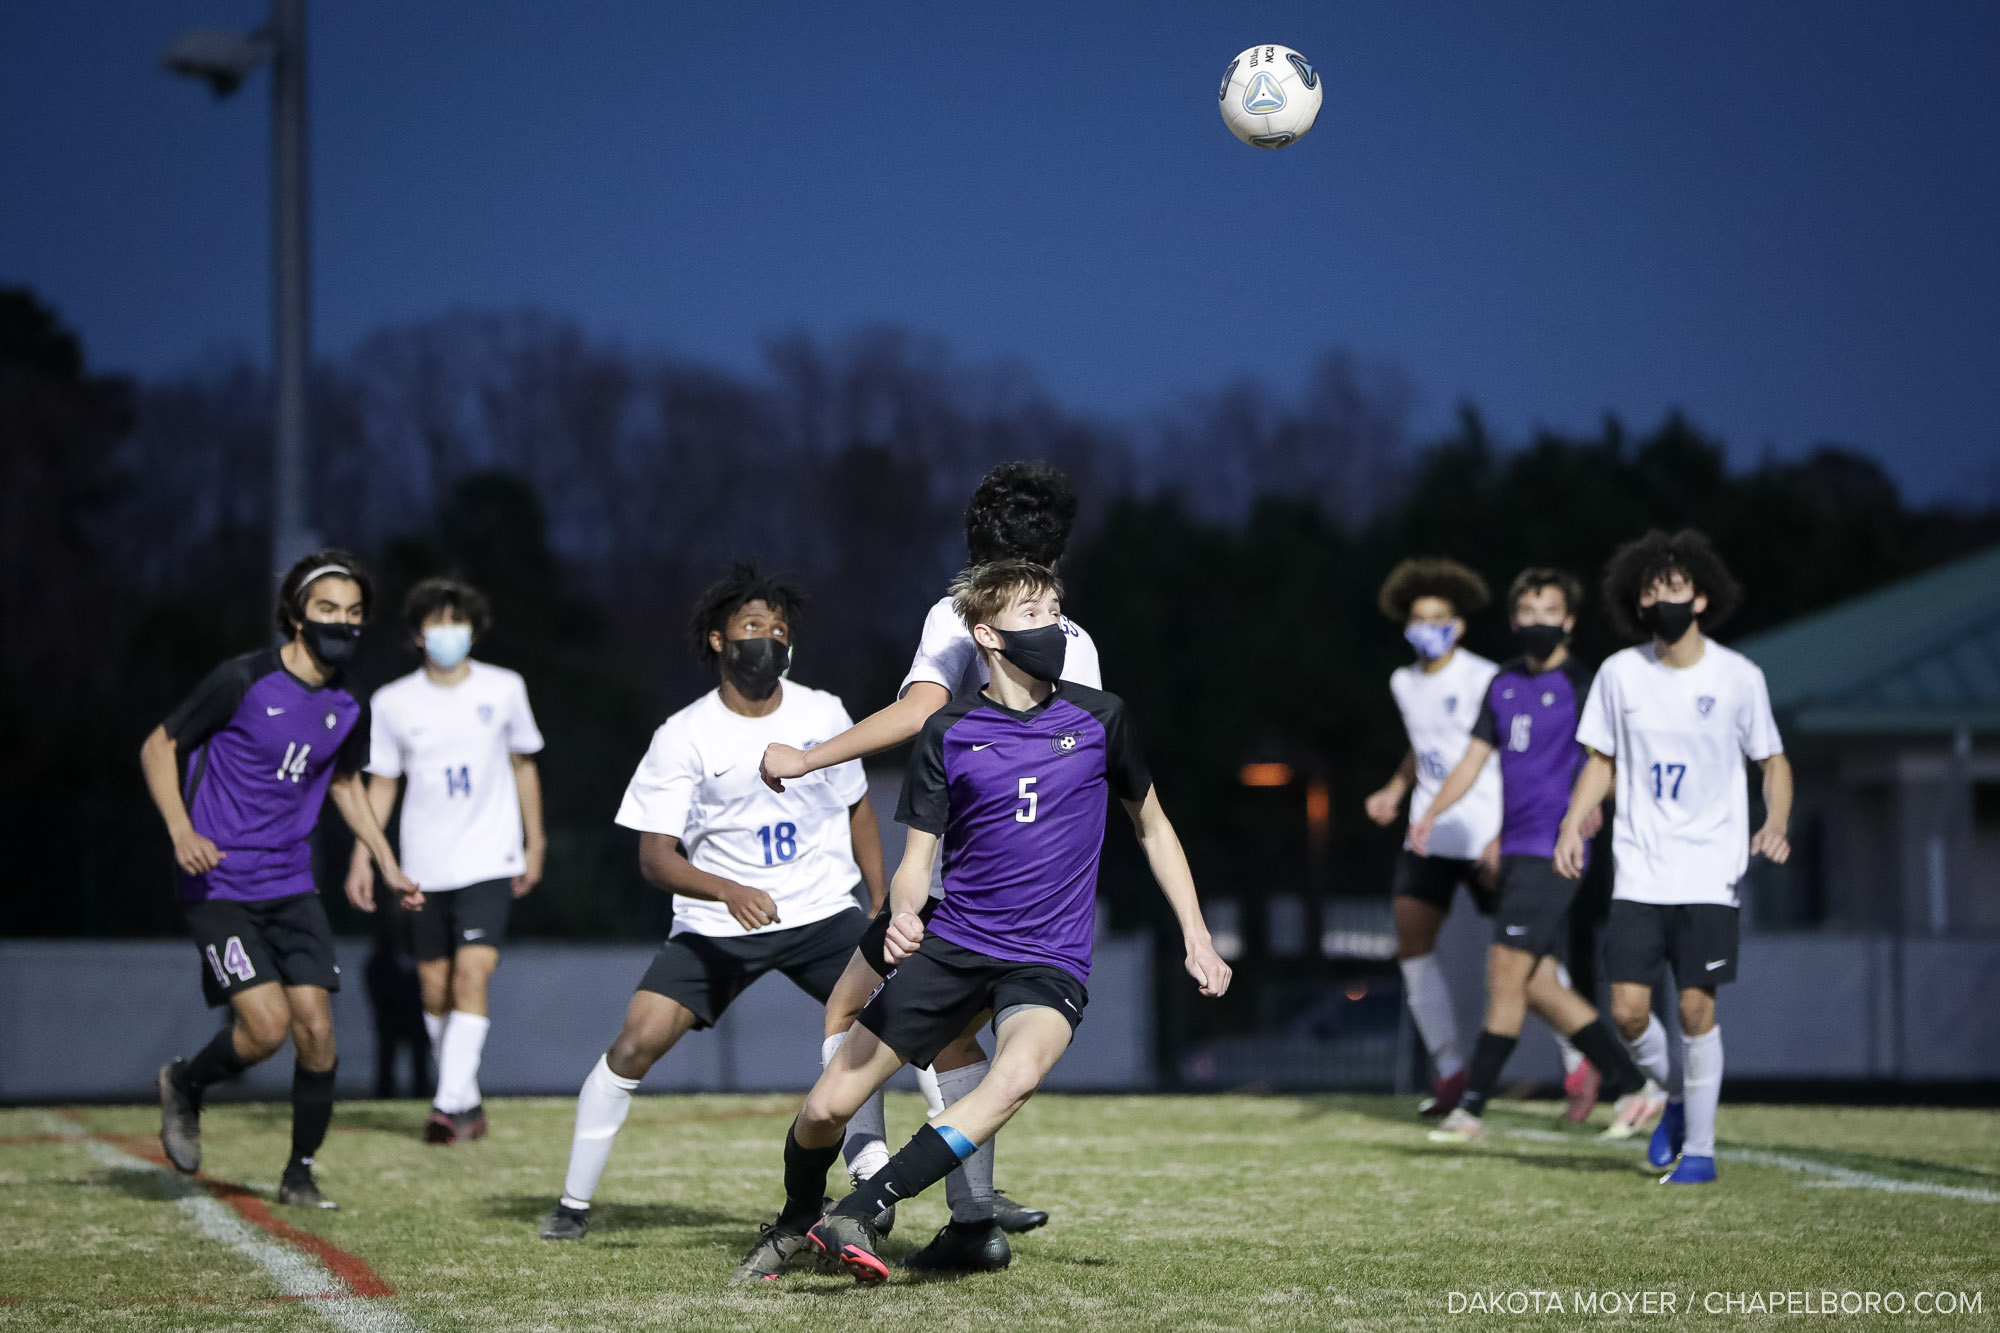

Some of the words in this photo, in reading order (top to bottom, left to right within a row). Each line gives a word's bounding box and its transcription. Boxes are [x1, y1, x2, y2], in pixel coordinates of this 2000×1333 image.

[276, 741, 312, 783] 14
[445, 765, 472, 799] 14
[1650, 762, 1686, 800] 17
[1015, 777, 1038, 823] 5
[756, 821, 797, 866] 18
[205, 936, 256, 988] 14
